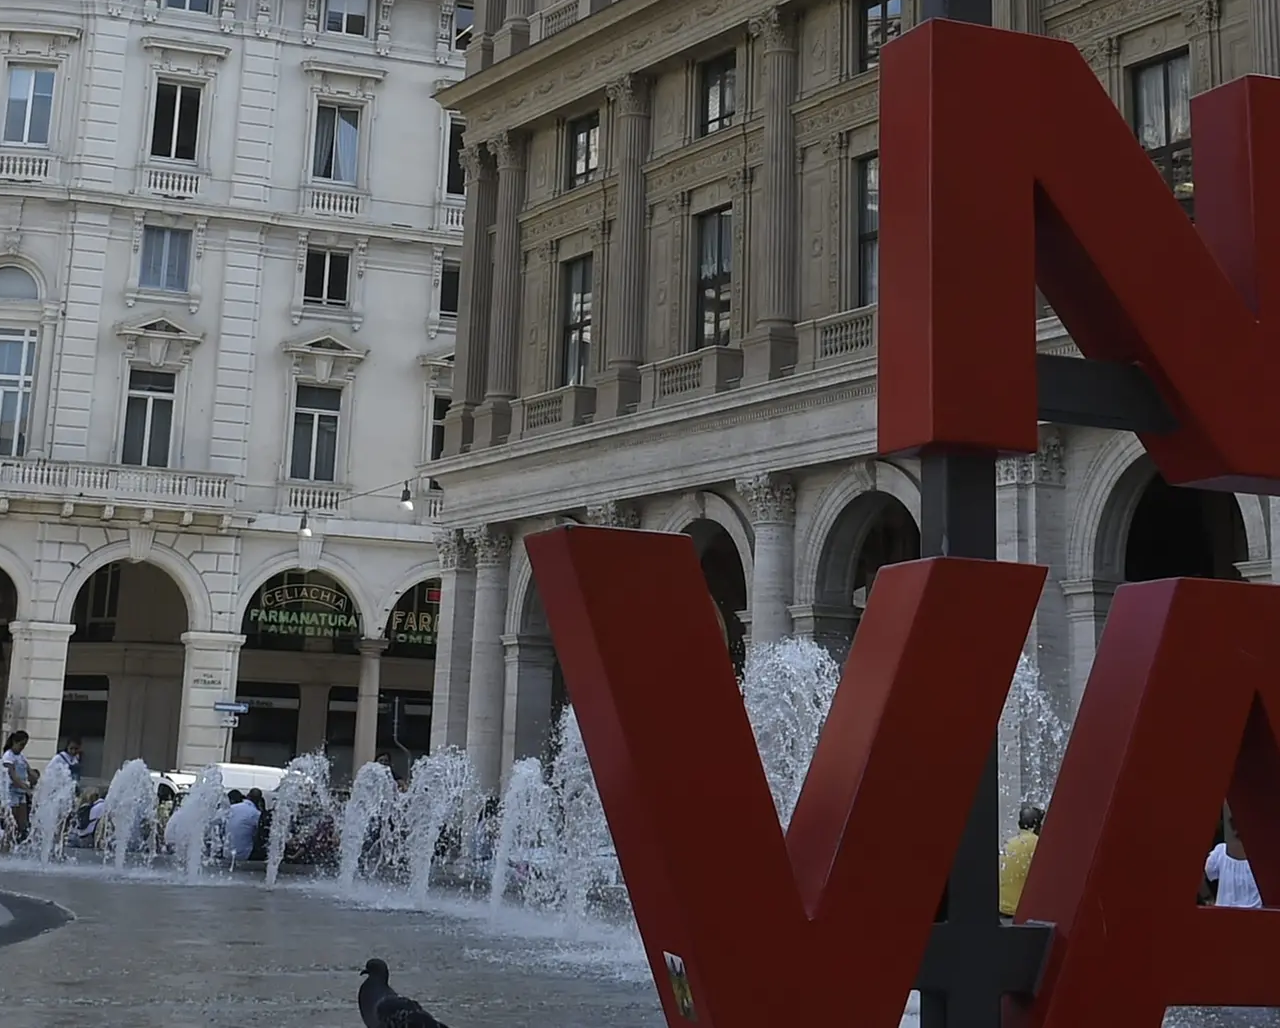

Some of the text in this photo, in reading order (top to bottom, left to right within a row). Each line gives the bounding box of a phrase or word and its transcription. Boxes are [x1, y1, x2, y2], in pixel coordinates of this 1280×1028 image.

[263, 587, 345, 609] CELIACHIA
[249, 608, 358, 628] FARMANATURA
[396, 633, 437, 645] OME
